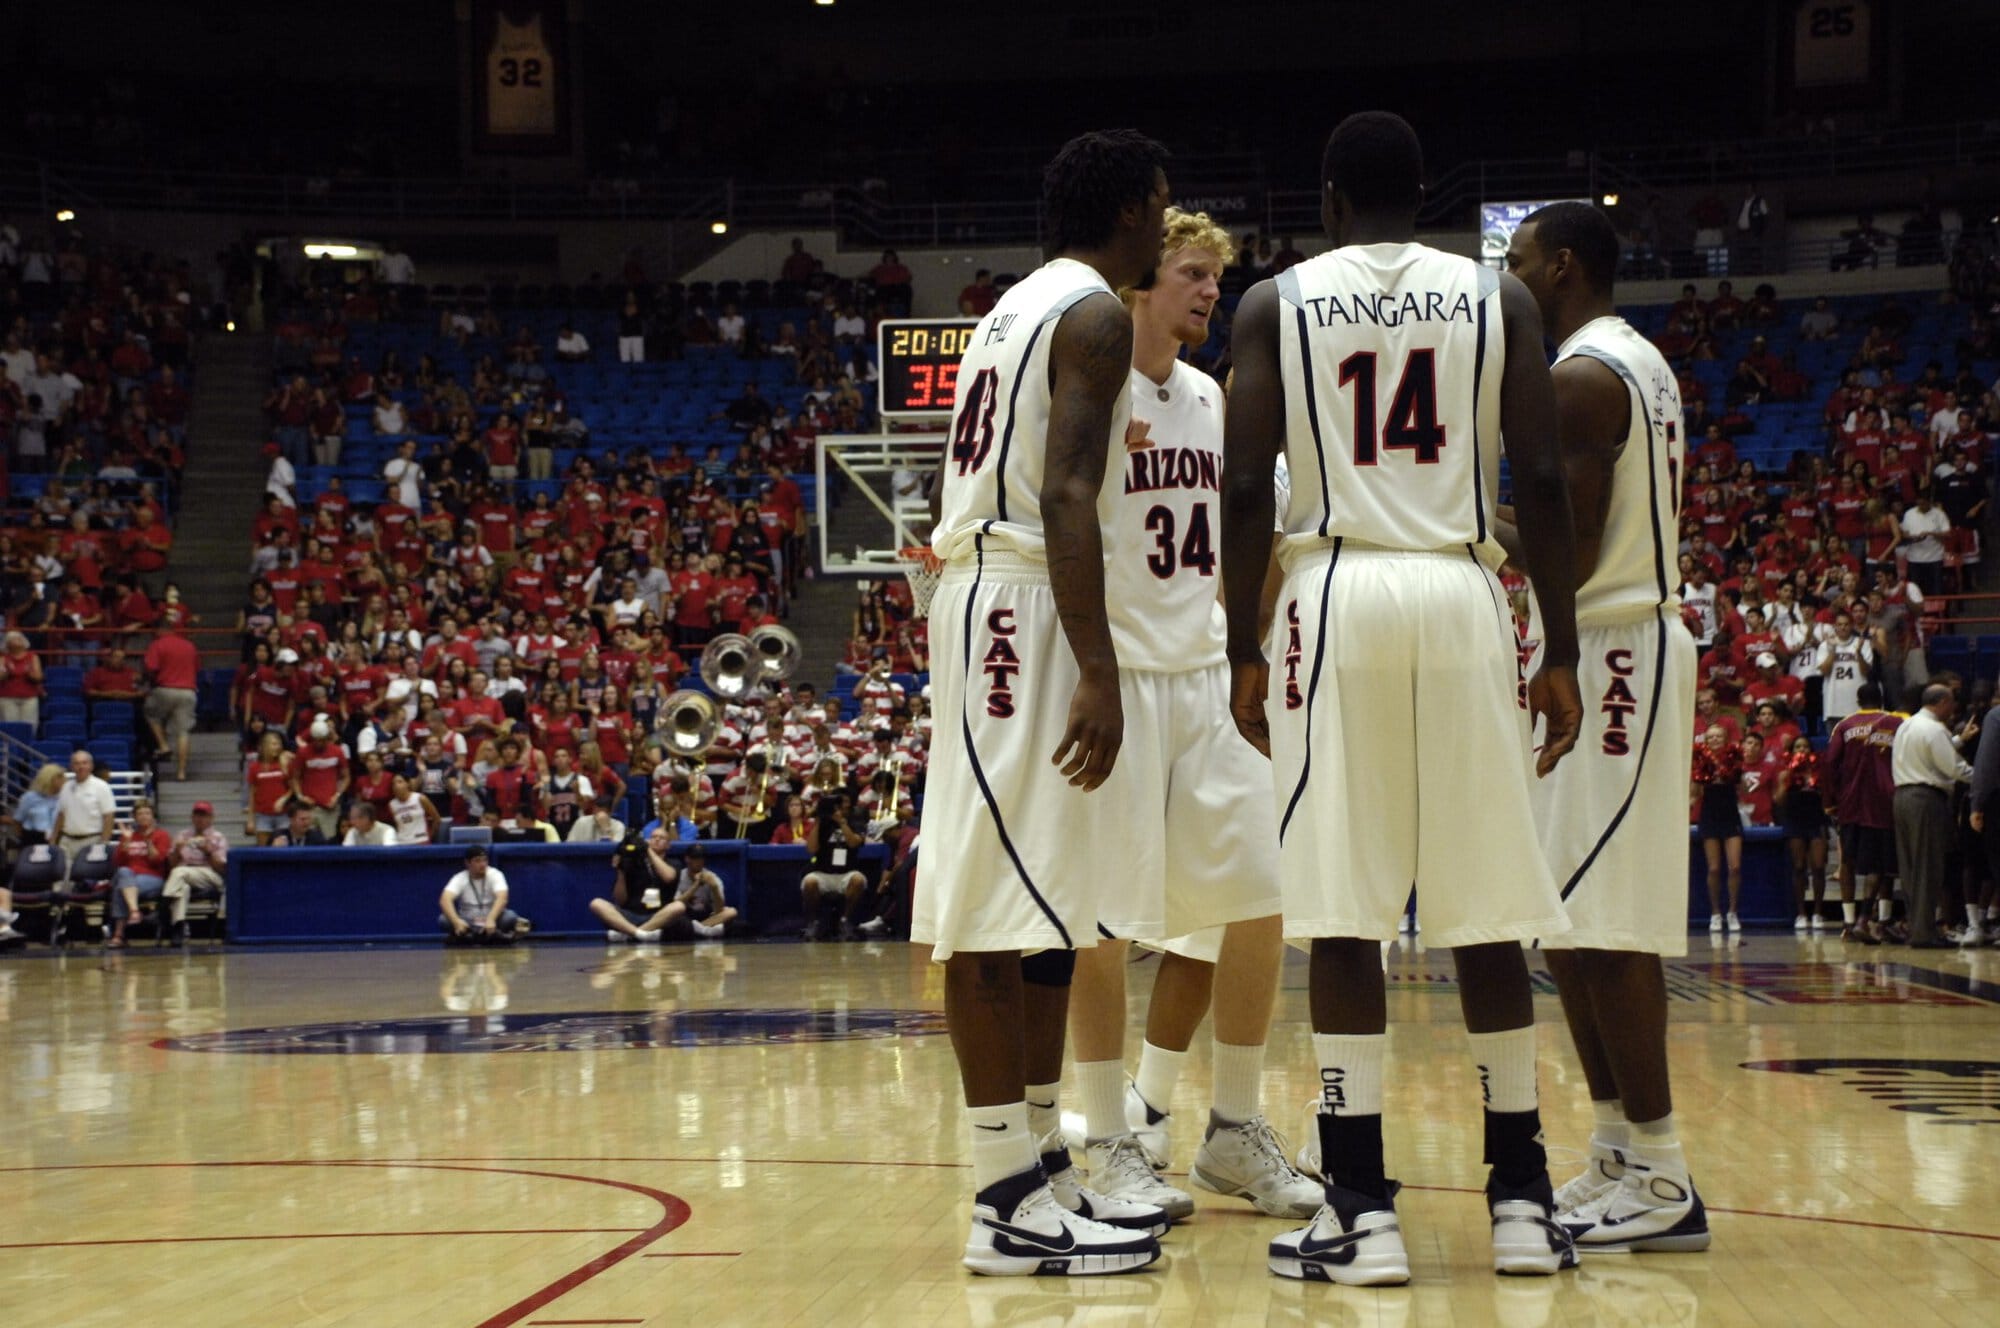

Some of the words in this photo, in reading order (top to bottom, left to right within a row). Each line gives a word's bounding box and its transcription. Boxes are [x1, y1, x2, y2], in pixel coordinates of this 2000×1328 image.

[1811, 6, 1853, 37] 25
[499, 59, 541, 87] 32
[1306, 292, 1474, 328] TANGARA
[953, 365, 998, 476] 43
[1338, 347, 1446, 465] 14
[1125, 447, 1223, 495] RIZON
[1145, 502, 1216, 579] 34
[983, 608, 1020, 718] CATS
[1285, 599, 1303, 710] CATS
[1836, 667, 1853, 680] 24
[1602, 649, 1637, 755] CATS
